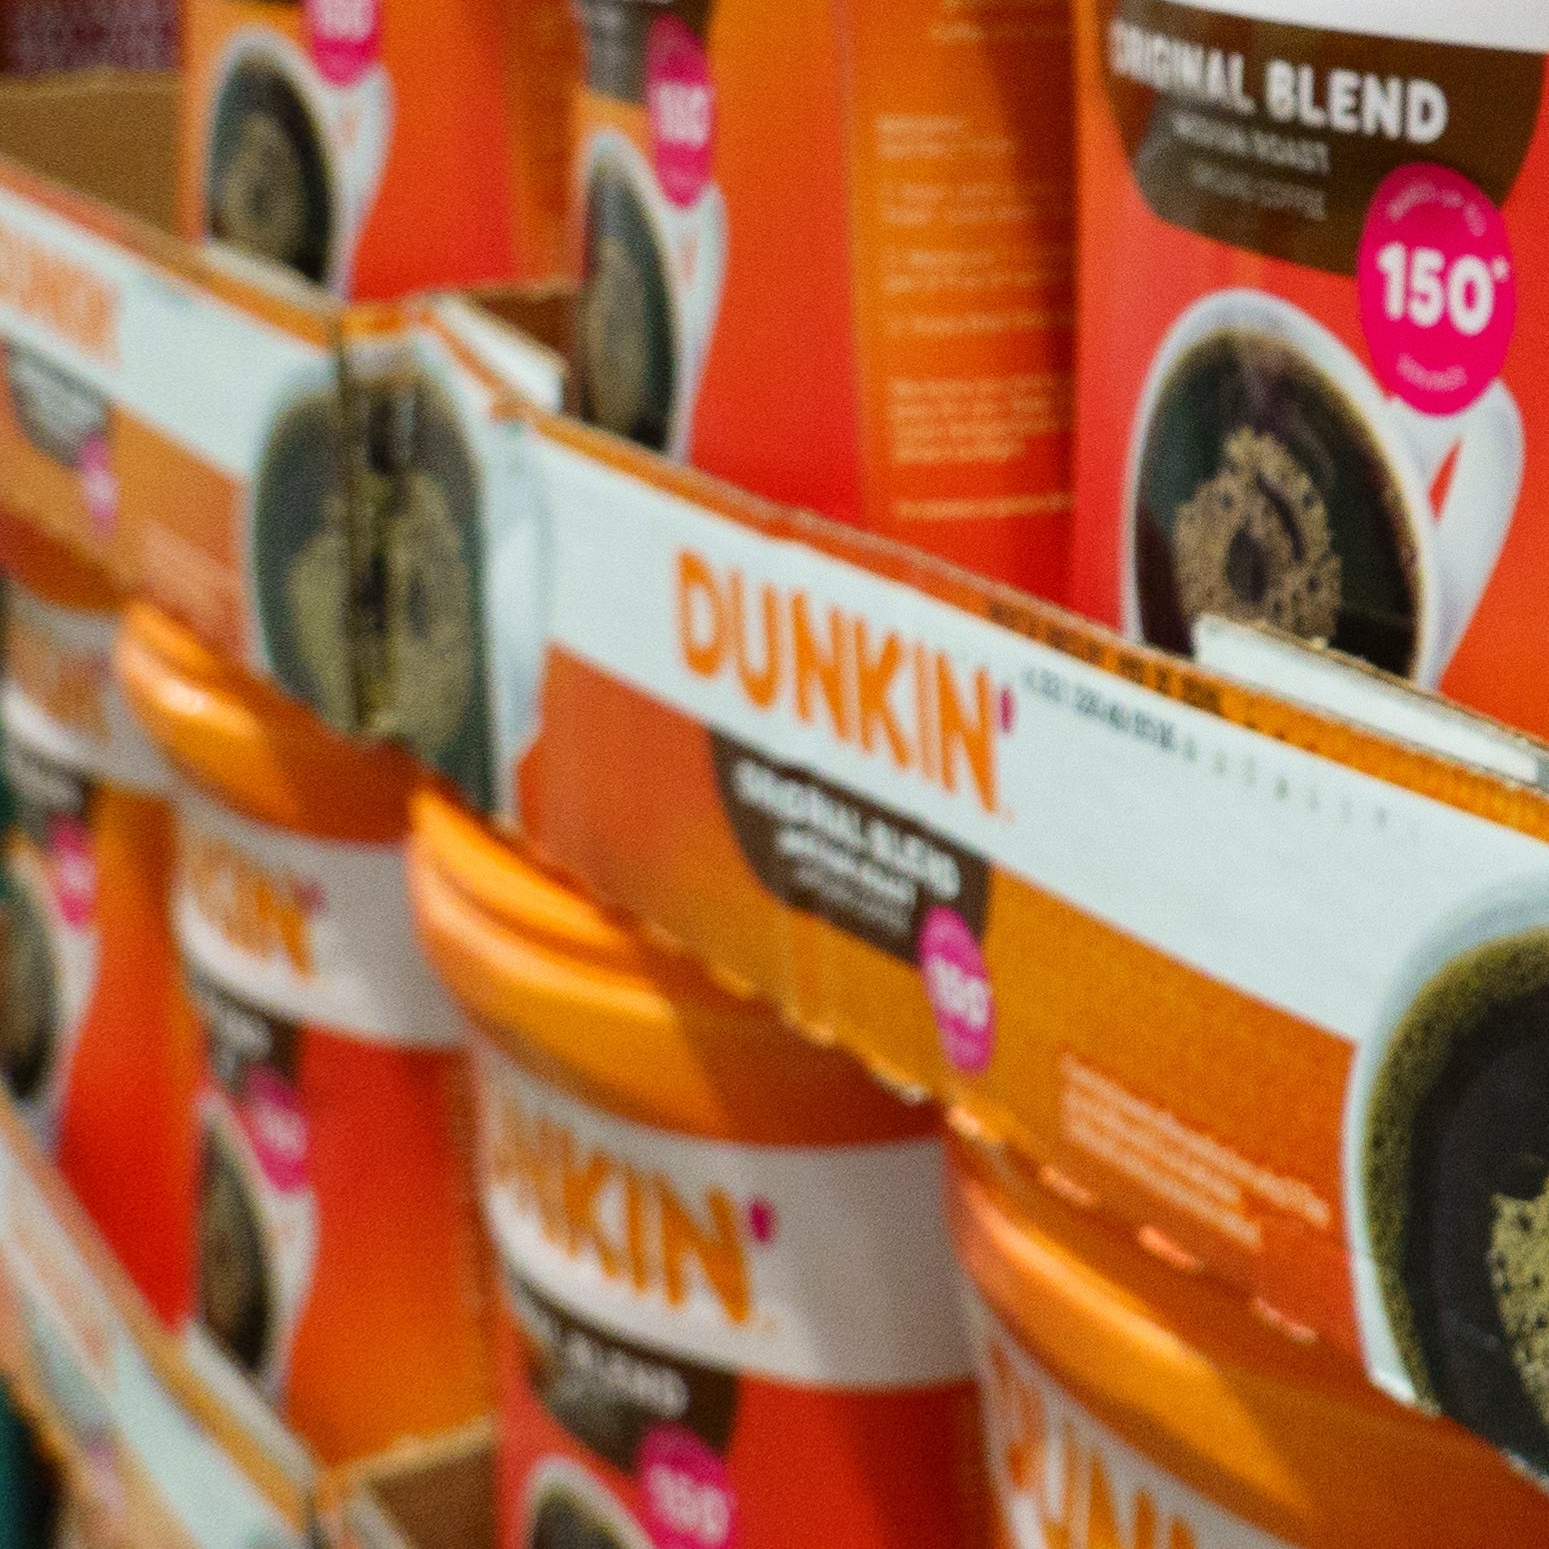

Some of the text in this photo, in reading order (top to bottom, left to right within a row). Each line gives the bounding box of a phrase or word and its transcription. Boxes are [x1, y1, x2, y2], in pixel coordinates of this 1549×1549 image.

[1109, 20, 1256, 117] ORIGINAL
[1265, 59, 1450, 145] BLEND
[674, 546, 1014, 816] DUNKIN'
